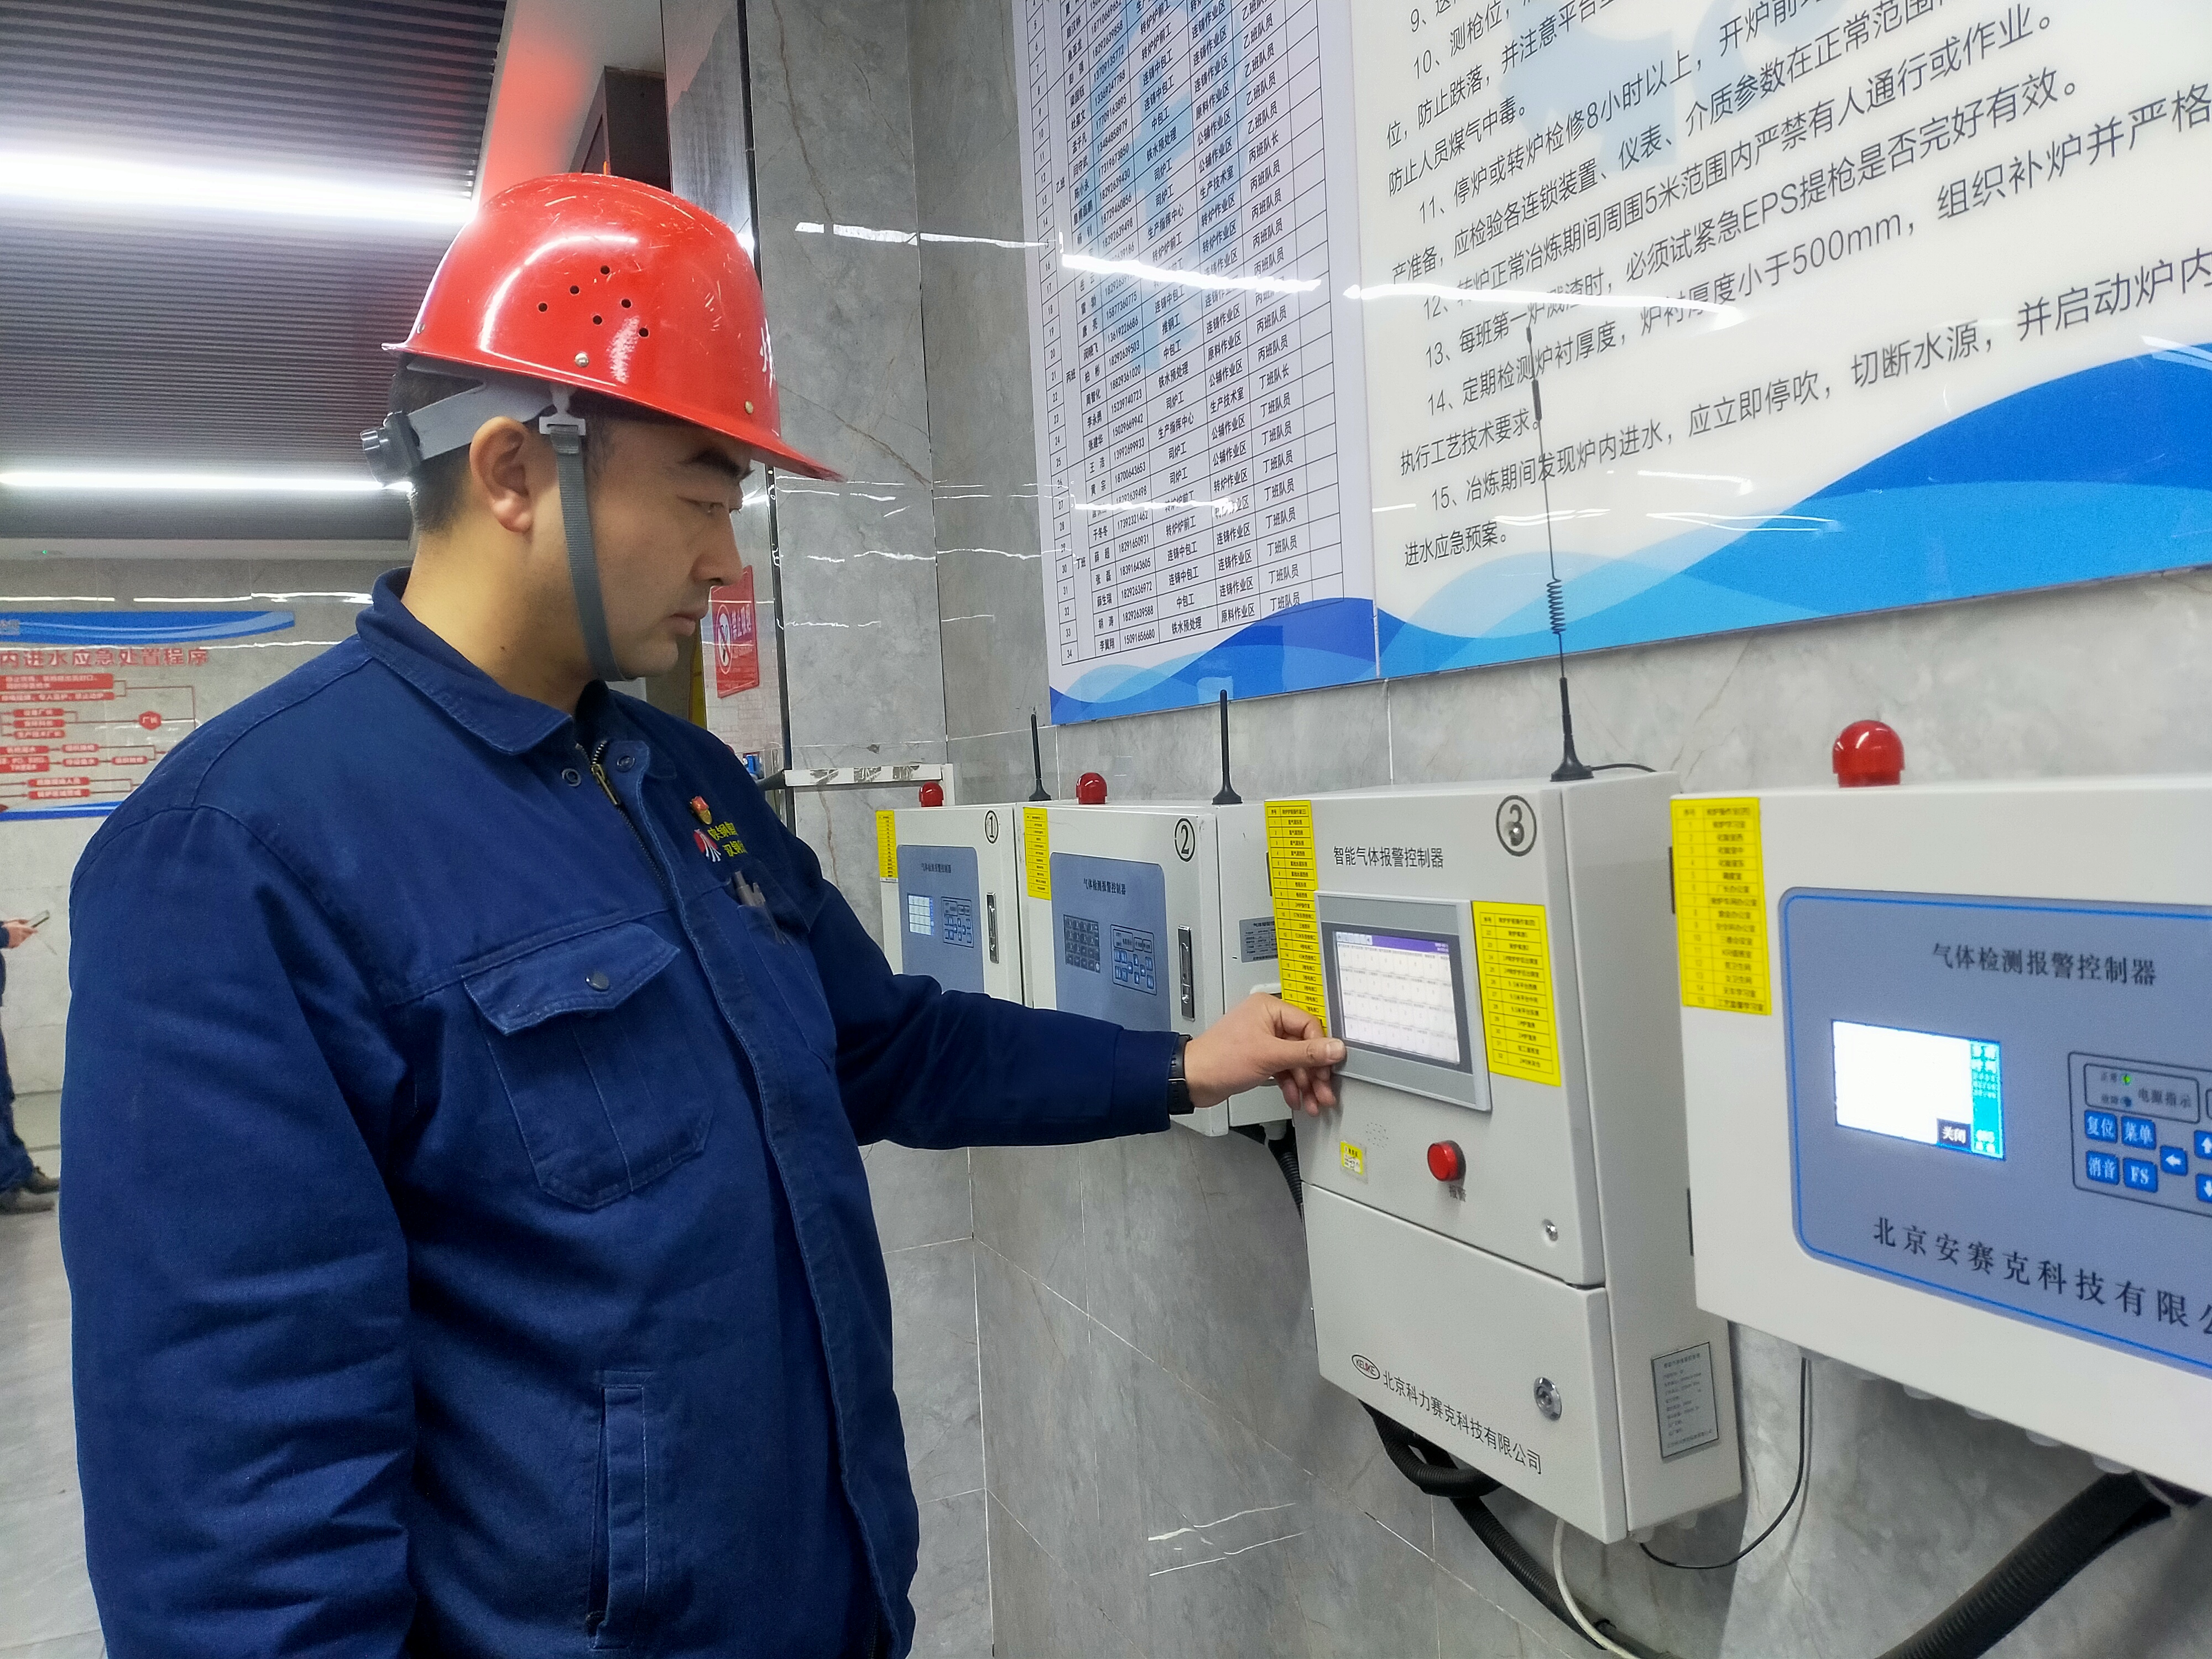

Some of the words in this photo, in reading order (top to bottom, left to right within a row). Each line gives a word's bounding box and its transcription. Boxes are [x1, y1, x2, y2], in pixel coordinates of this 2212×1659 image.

[1141, 22, 1172, 61] 转炉炉前工
[1142, 47, 1173, 87] 连铸中包工
[1144, 74, 1175, 112] 连铸中包工
[1193, 24, 1227, 67] 连铸作业区
[1151, 105, 1170, 131] 中包工
[1194, 51, 1229, 94] 连铸作业区
[1243, 12, 1273, 50] 乙班队员
[1146, 126, 1177, 162] 铁水预处理
[1195, 79, 1230, 121] 原料作业区
[1244, 41, 1275, 78] 乙班队员
[1153, 156, 1172, 181] 司炉工
[1197, 106, 1231, 147] 公辅作业区
[1245, 70, 1276, 106] 乙班队员
[1147, 203, 1184, 241] 生产指挥中心
[1199, 164, 1234, 201] 生产技术室
[1248, 129, 1279, 164] 丙班队长
[1155, 183, 1174, 207] 司炉工
[1198, 135, 1233, 174] 公辅作业区
[1247, 100, 1277, 134] 乙班队员
[1389, 95, 1525, 197] 防止人员煤气中毒。
[1201, 191, 1235, 227] 转炉作业区
[1250, 158, 1280, 193] 丙班队员
[1050, 347, 1056, 359] 20
[1202, 218, 1237, 254] 转炉作业区
[1251, 187, 1282, 221] 丙班队员
[1252, 217, 1283, 249] 丙班队员
[1052, 391, 1058, 403] 22
[1161, 312, 1181, 336] 推钢工
[1253, 246, 1284, 276] 丙班队员
[1163, 338, 1182, 360] 中包工
[1206, 302, 1240, 335] 连铸作业区
[1055, 435, 1060, 446] 24
[1157, 360, 1188, 388] 铁水预处理
[1207, 330, 1241, 362] 原料作业区
[1256, 304, 1287, 335] 丙班队员
[1157, 411, 1194, 440] 生产指挥中心
[1209, 386, 1244, 414] 生产技术室
[1259, 362, 1289, 390] 丁班队长
[1165, 390, 1185, 410] 司炉工
[1208, 357, 1243, 388] 公辅作业区
[1257, 333, 1288, 362] 丙班队员
[1058, 499, 1063, 510] 27
[1167, 441, 1187, 460] 司炉工
[1211, 412, 1245, 441] 公辅作业区
[1260, 391, 1291, 418] 丁班队员
[1168, 466, 1188, 484] 司炉工
[1212, 439, 1246, 466] 公辅作业区
[1261, 420, 1292, 445] 丁班队员
[1213, 467, 1248, 493] 转炉作业区
[1262, 448, 1293, 473] 丁班队员
[1400, 407, 1540, 476] 执行工艺技术要求。
[1061, 564, 1067, 573] 30
[1165, 515, 1196, 537] 转炉炉前工
[1264, 477, 1295, 502] 丁班队员
[1062, 586, 1068, 595] 31
[1167, 540, 1198, 562] 连铸中包工
[1216, 521, 1250, 545] 连铸作业区
[1265, 506, 1296, 529] 丁班队员
[1405, 520, 1507, 567] 进水应急预案。
[1064, 606, 1070, 616] 32
[1168, 565, 1199, 586] 连铸中包工
[1217, 548, 1252, 571] 连铸作业区
[1266, 534, 1297, 556] 丁班队员
[1176, 592, 1194, 609] 中包工
[1219, 575, 1254, 597] 连铸作业区
[1267, 563, 1299, 584] 丁班队员
[1066, 648, 1072, 659] 34
[1171, 615, 1202, 634] 铁水预处理
[1220, 602, 1255, 623] 原料作业区
[1269, 591, 1300, 611] 丁班队员
[1333, 845, 1444, 869] 智能气体报警控制器
[1933, 942, 2156, 986] 气体检测报警控制器
[1383, 1370, 1542, 1475] 北京科力赛克科技有限公司
